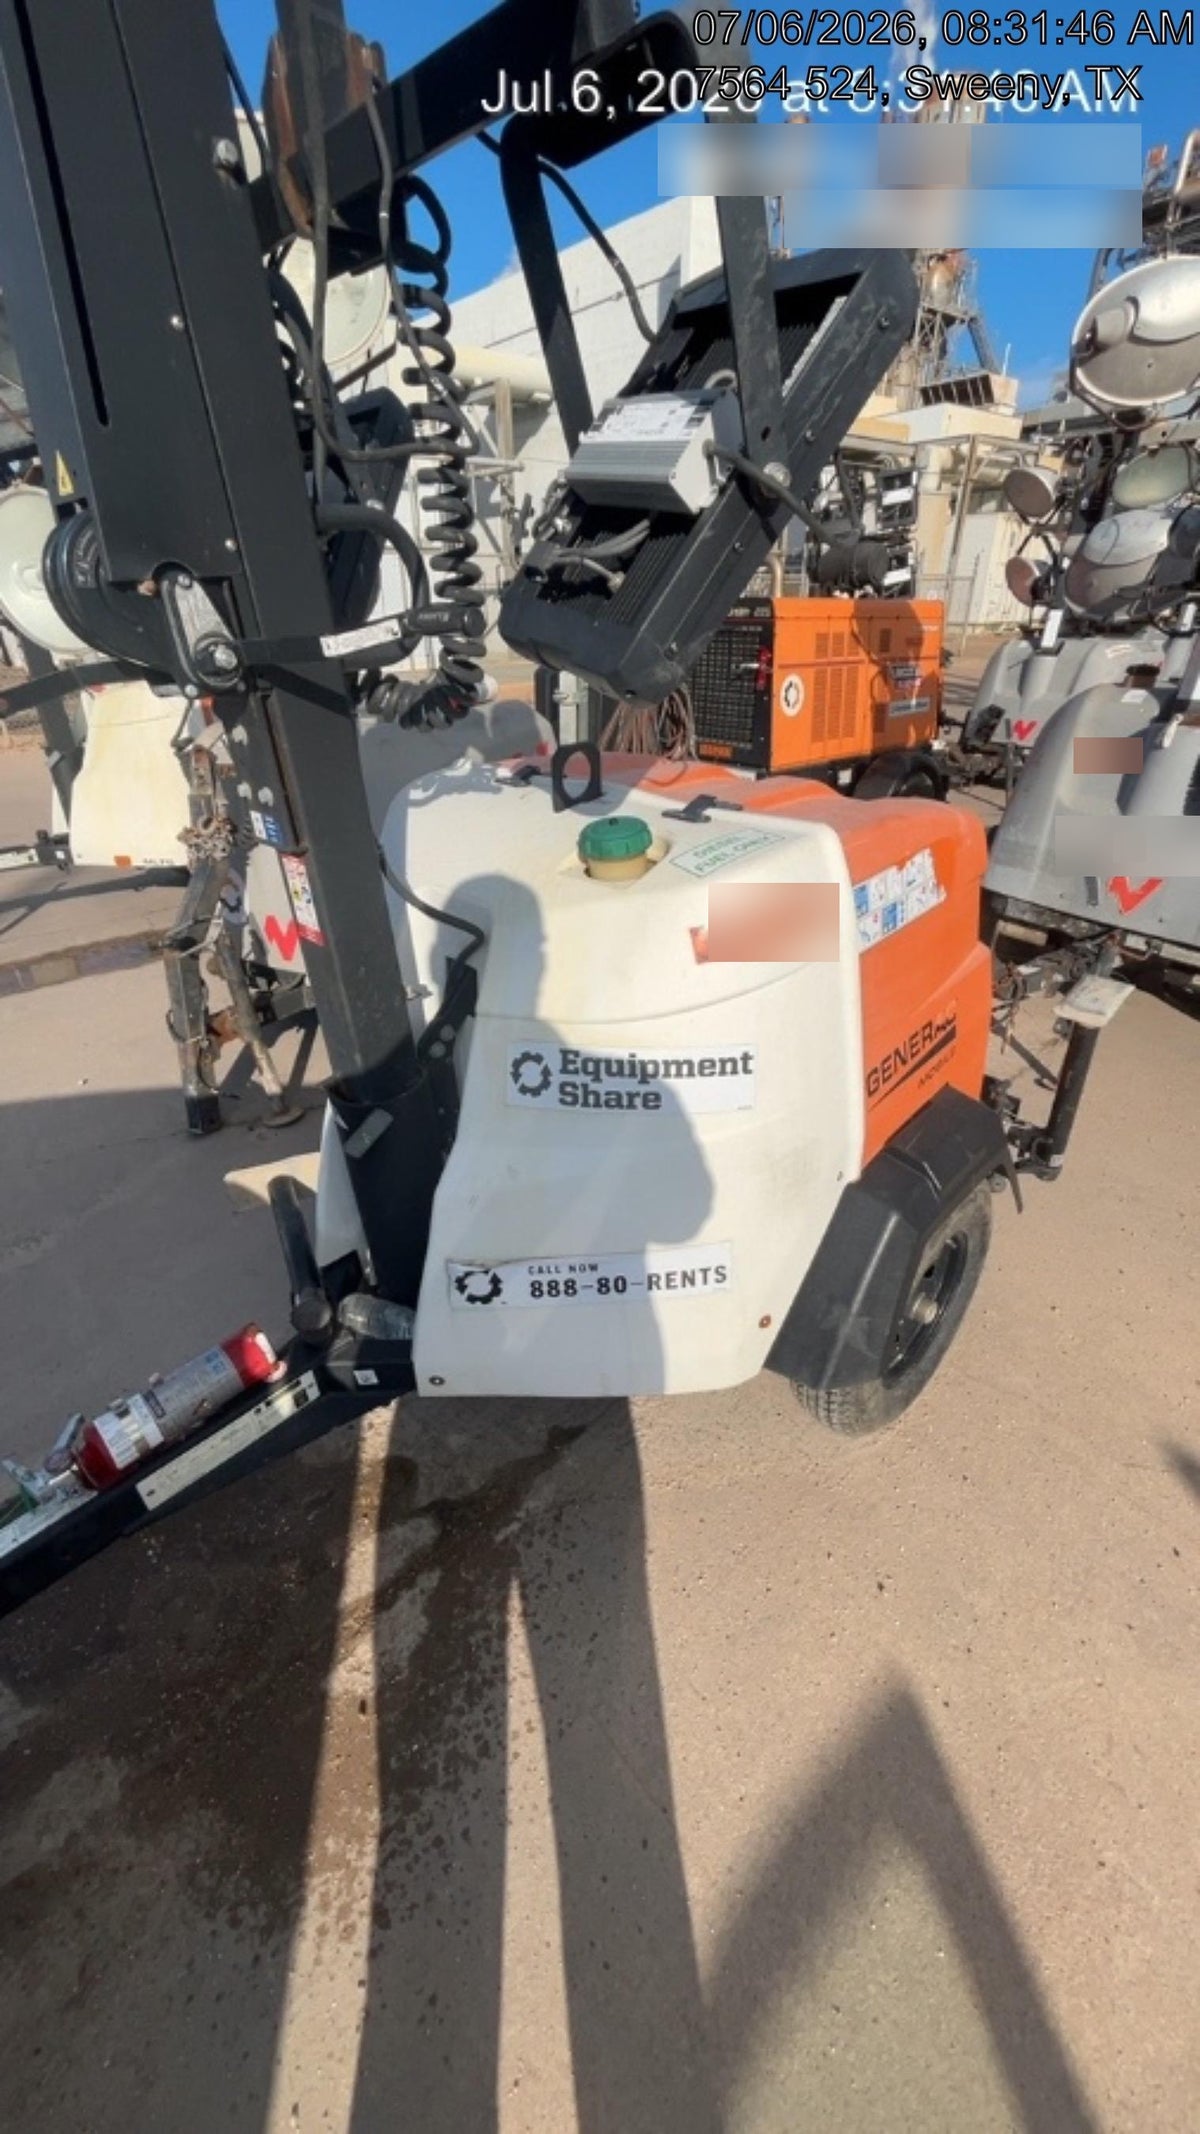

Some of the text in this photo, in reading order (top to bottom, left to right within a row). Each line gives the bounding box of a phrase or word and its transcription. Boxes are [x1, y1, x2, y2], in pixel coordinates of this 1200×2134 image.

[559, 1048, 754, 1084] Equipment
[558, 1081, 662, 1110] Share
[528, 1263, 599, 1275] CALL NOW
[530, 1265, 728, 1298] 888-80-RENTS
